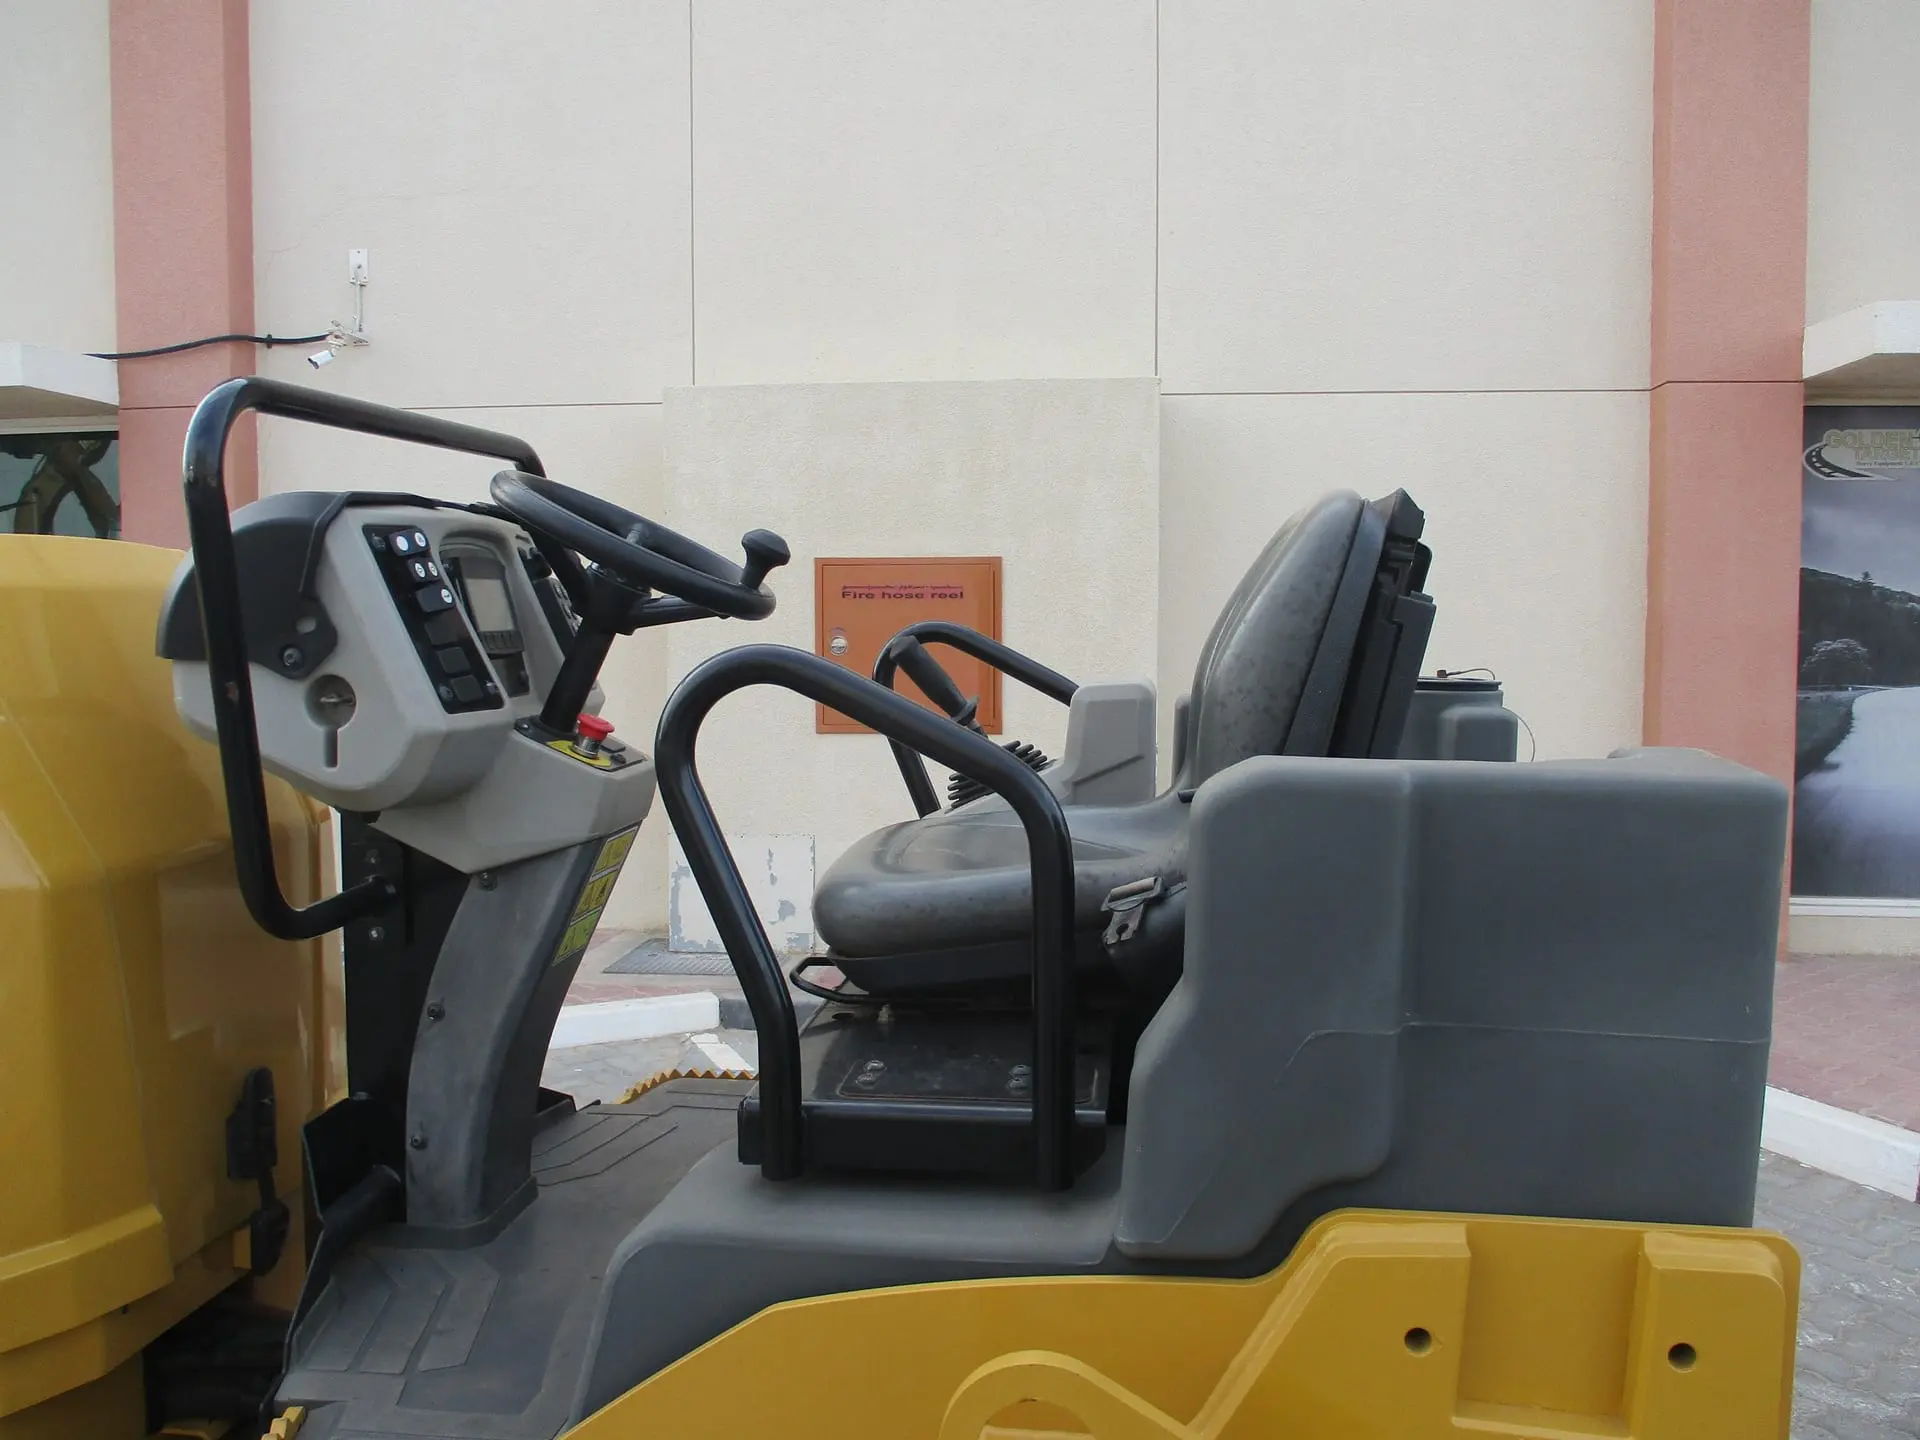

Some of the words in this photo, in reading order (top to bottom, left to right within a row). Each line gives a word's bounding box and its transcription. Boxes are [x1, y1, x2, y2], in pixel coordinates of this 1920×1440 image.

[1825, 430, 1913, 448] GOLDEN
[841, 591, 875, 599] Fire
[881, 591, 924, 599] hose
[930, 591, 964, 599] reel
